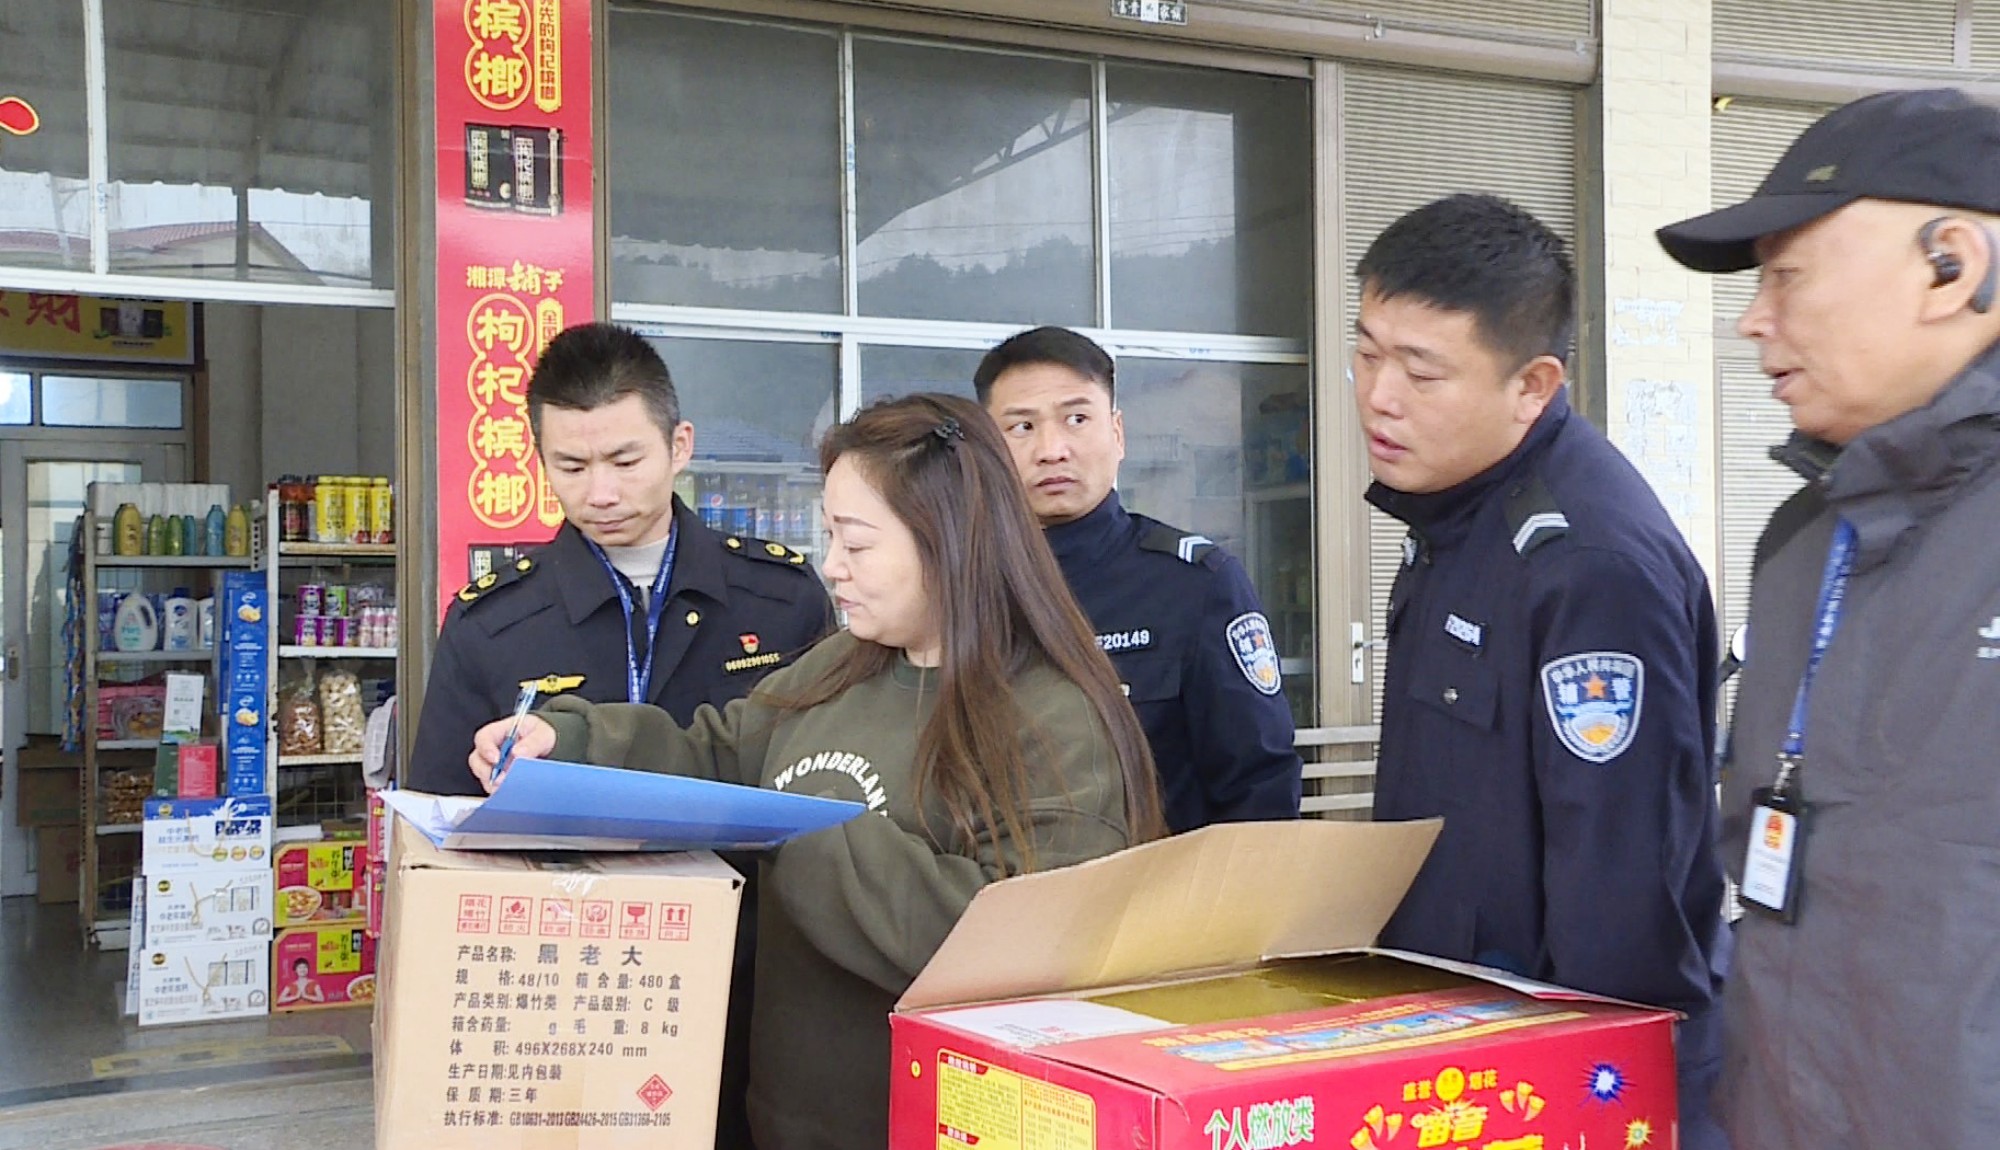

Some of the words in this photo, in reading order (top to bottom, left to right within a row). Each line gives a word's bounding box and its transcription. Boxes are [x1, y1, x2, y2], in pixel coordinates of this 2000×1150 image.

[472, 0, 525, 99] 槟榔
[476, 306, 528, 517] 枸杞槟榔
[457, 945, 517, 963] 产品名称:
[537, 943, 644, 967] 黑老大
[518, 972, 560, 988] 48/10
[622, 1045, 648, 1058] mm
[1203, 1096, 1315, 1150] 个人燃放类
